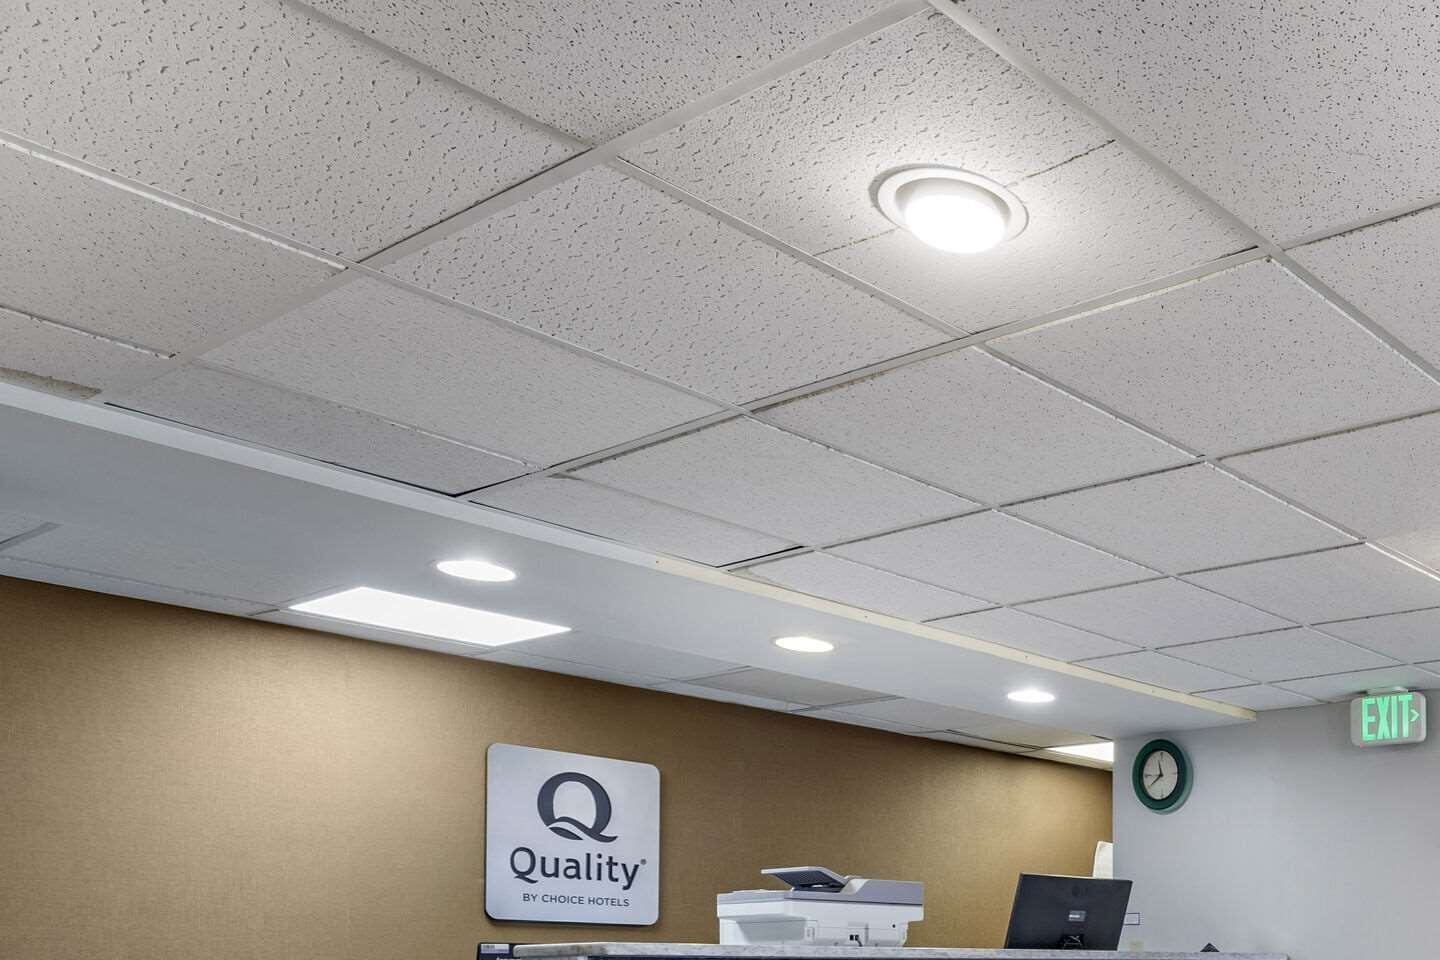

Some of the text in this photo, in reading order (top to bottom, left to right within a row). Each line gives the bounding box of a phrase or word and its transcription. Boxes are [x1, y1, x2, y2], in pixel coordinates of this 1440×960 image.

[1361, 694, 1414, 741] EXIT
[537, 771, 618, 843] Q
[510, 846, 640, 891] Quality
[522, 893, 630, 907] BY CHOICE HOTELS
